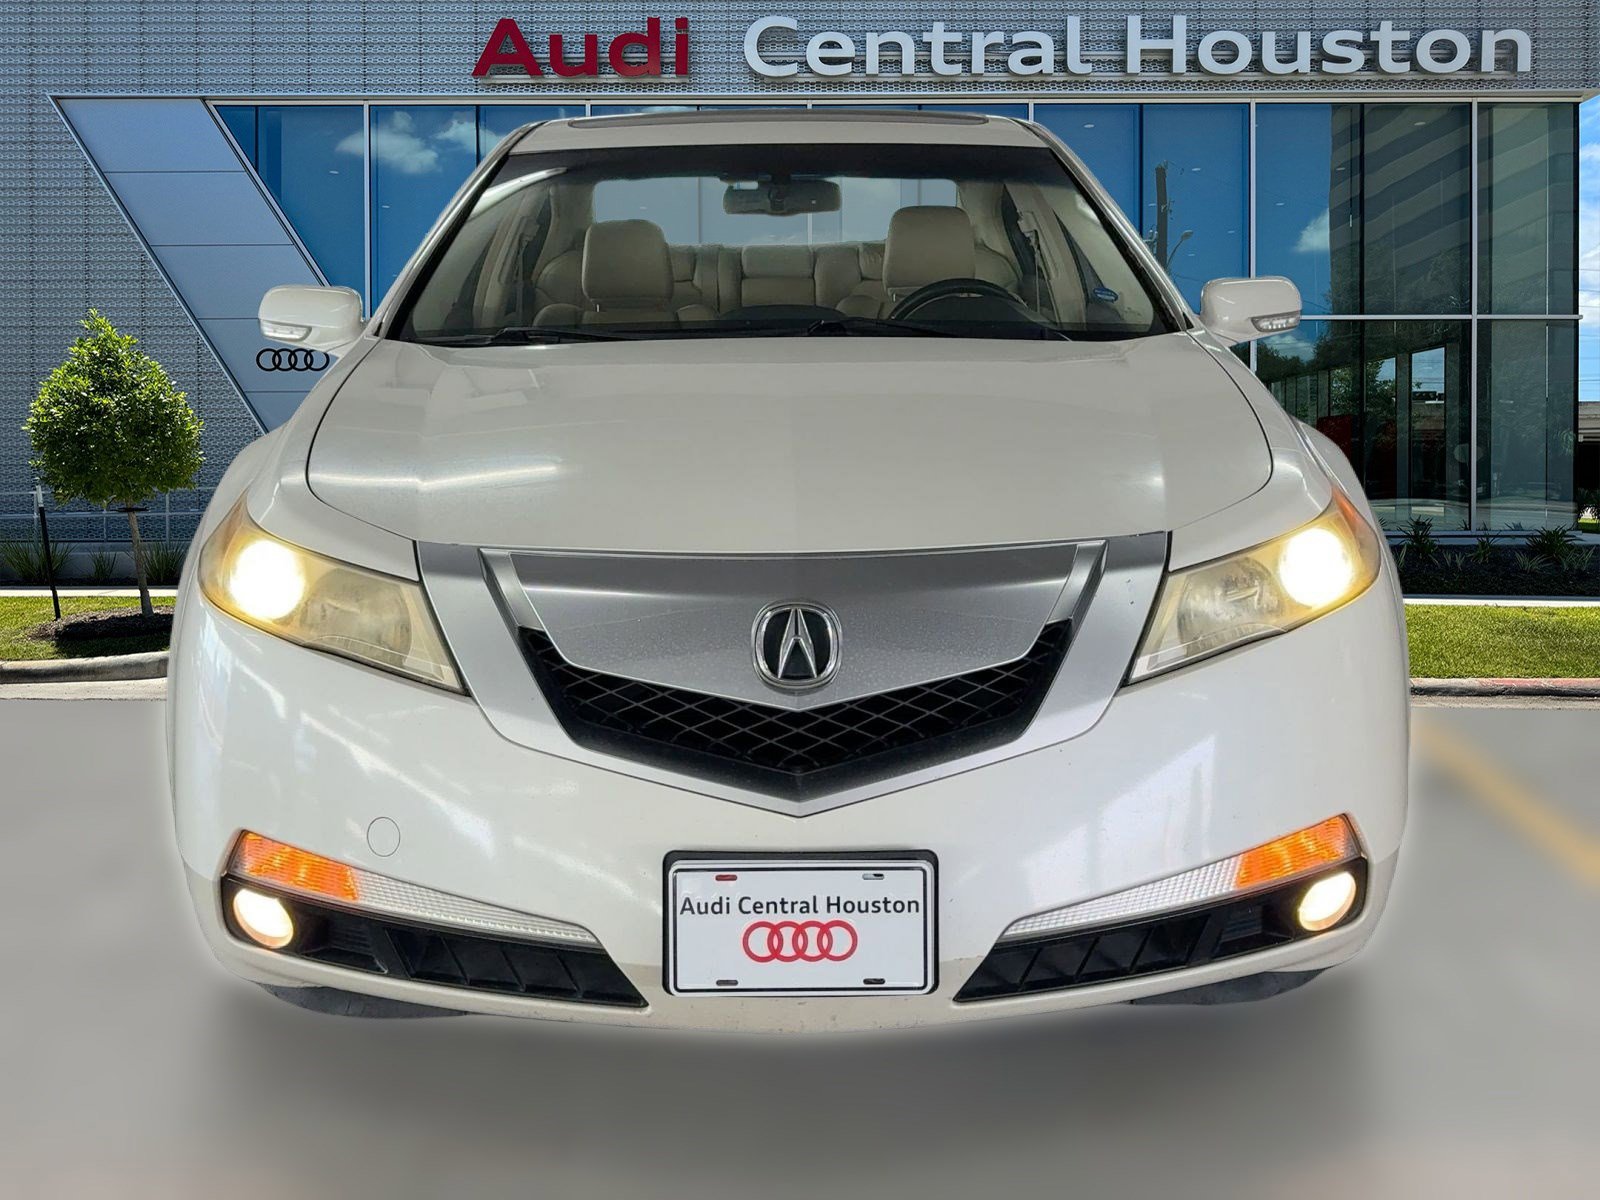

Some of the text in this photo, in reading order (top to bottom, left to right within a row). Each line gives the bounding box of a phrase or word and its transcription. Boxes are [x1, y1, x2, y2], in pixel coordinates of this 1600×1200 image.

[472, 14, 1532, 78] Audi Central Houston
[680, 895, 920, 915] Audi Central Houston
